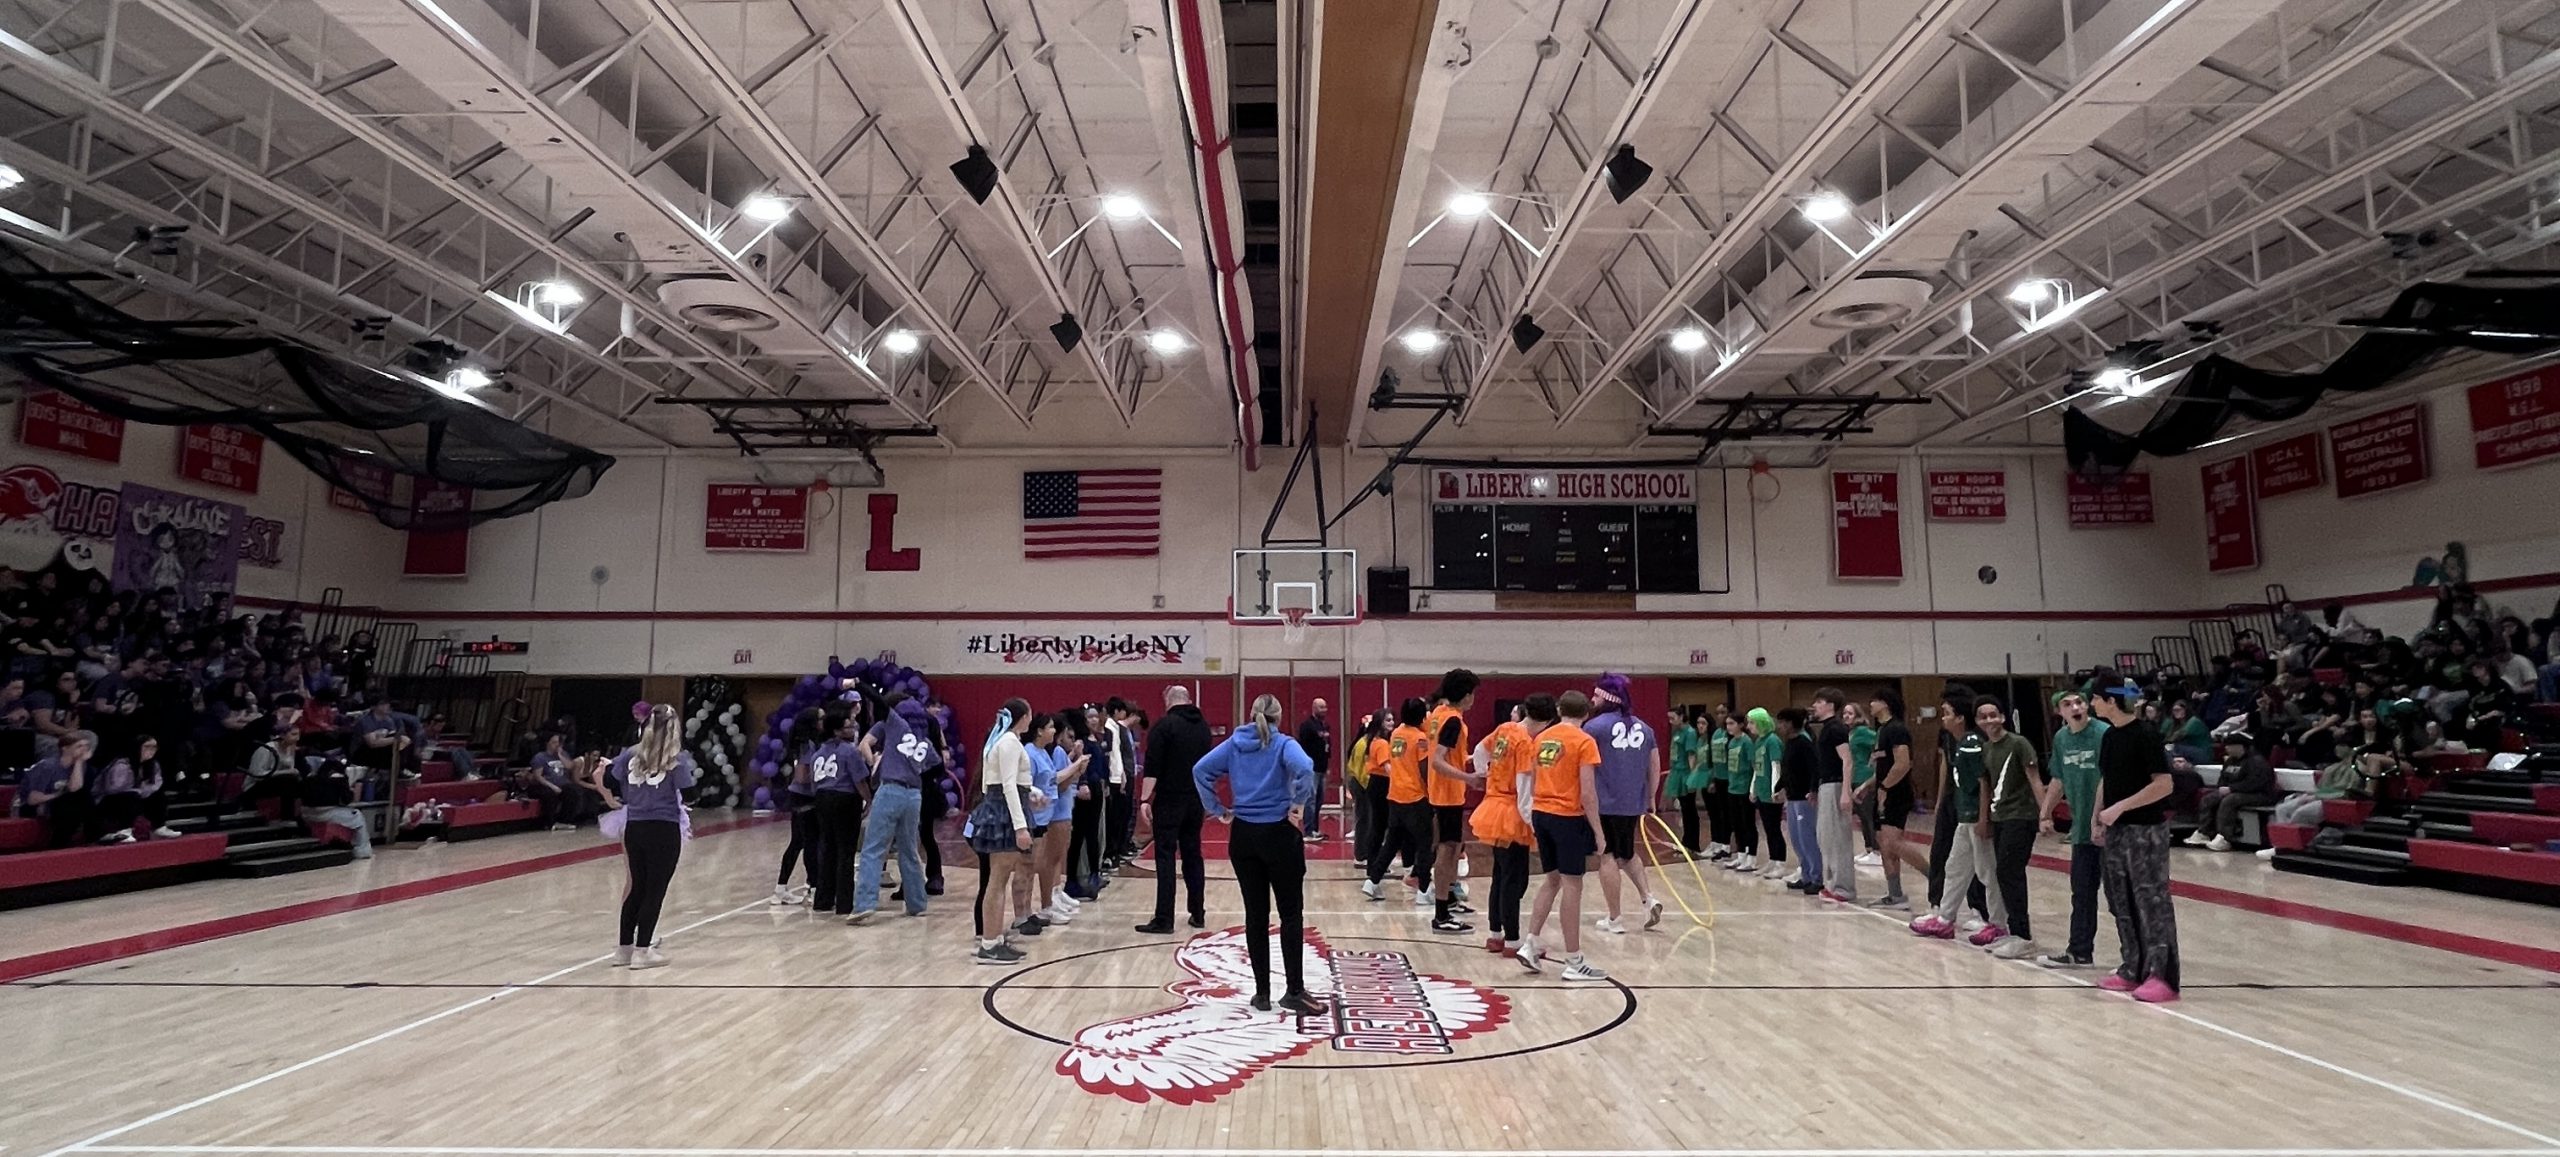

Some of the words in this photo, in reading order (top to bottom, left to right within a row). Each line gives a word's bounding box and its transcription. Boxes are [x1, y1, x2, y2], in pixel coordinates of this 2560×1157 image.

[58, 408, 121, 438] BASKETBALL
[2346, 442, 2408, 464] FOOTBALL
[1465, 473, 1550, 498] LIBERT
[1557, 473, 1606, 498] HIGH
[1611, 473, 1691, 498] SCHOOL
[1848, 474, 1883, 483] LIBERTY
[1937, 475, 1959, 484] LADY
[717, 487, 746, 496] LIBERTY
[733, 508, 752, 516] ALMA
[866, 494, 920, 571] L
[1502, 523, 1530, 532] HOME
[1598, 523, 1629, 533] GUEST
[967, 633, 1191, 658] #LibertyPrideNY
[1690, 653, 1708, 664] EXIT
[1835, 654, 1854, 664] EXIT
[1610, 721, 1645, 750] 26
[897, 732, 929, 762] 26
[813, 753, 838, 782] 26
[1331, 950, 1453, 1054] REDHAWKS
